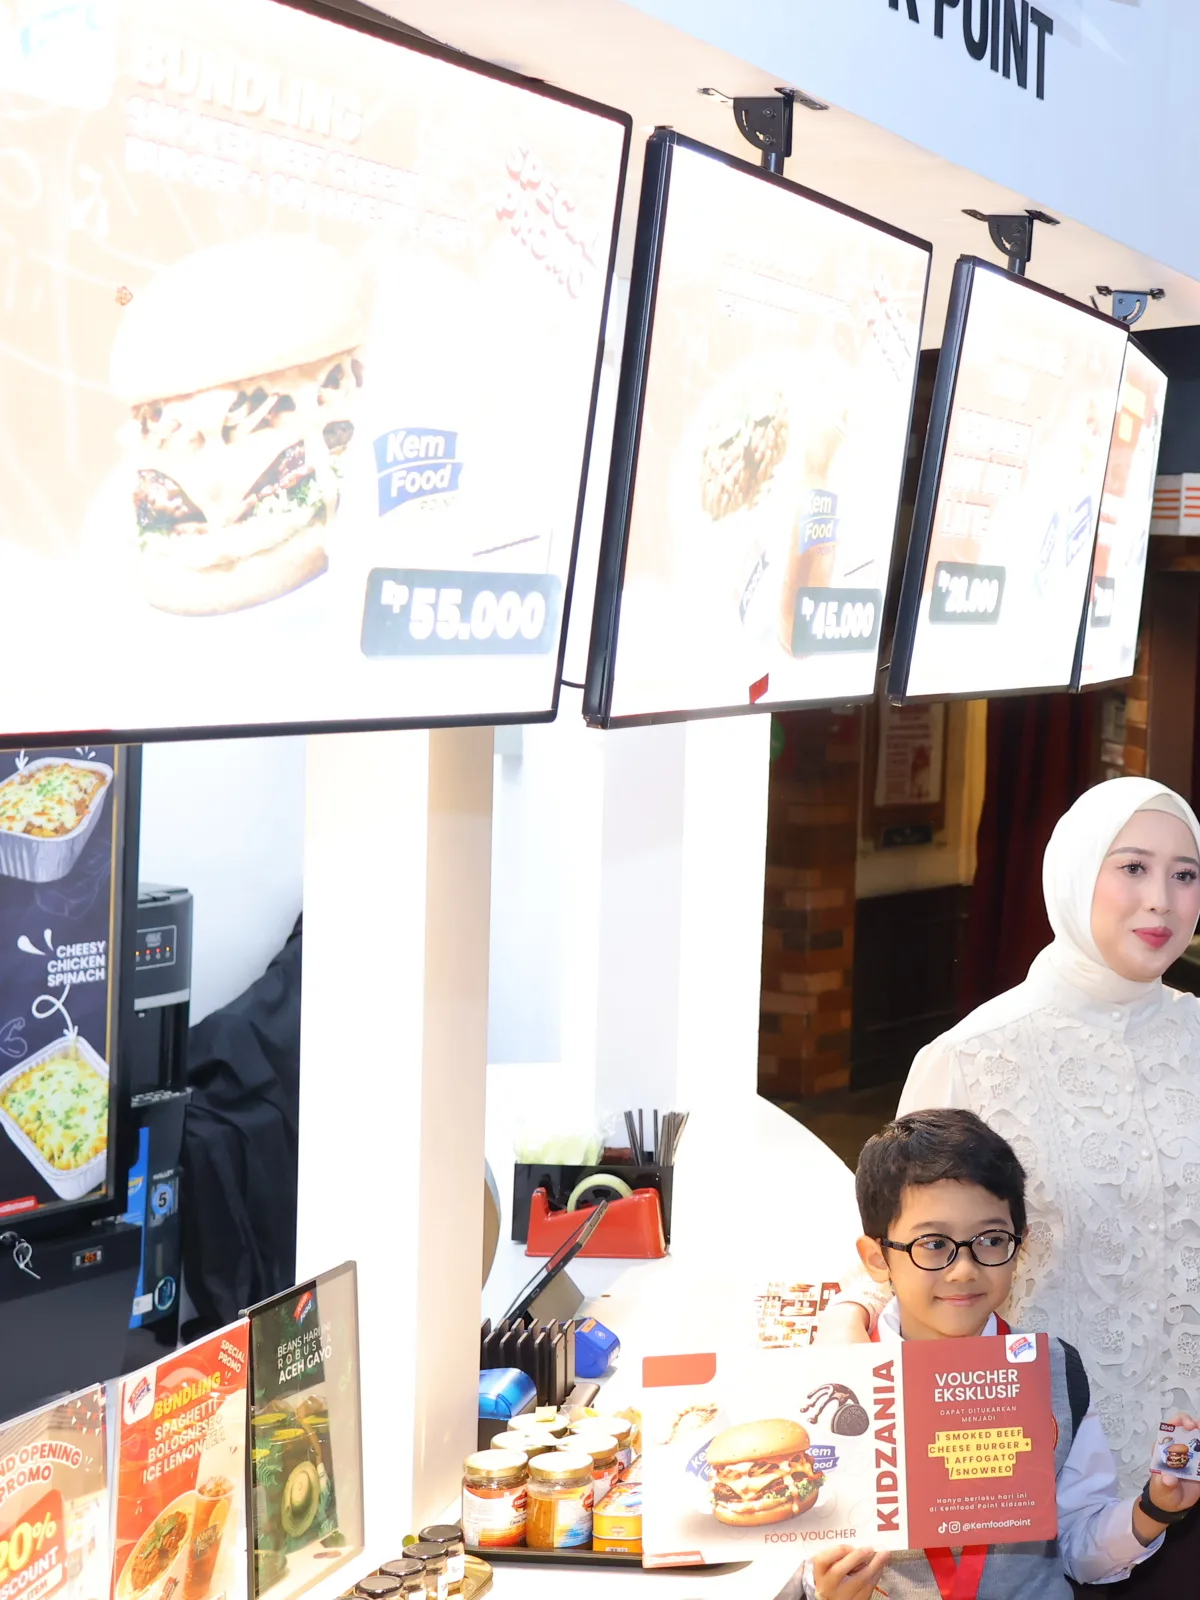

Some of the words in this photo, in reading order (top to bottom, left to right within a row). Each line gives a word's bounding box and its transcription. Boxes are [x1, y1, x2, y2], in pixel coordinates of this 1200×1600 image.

[386, 430, 446, 463] Kem
[391, 464, 452, 497] Food
[804, 520, 834, 543] Food
[56, 941, 106, 958] CHEESY
[47, 954, 105, 973] CHICKEN
[47, 967, 105, 987] SPINACH
[157, 1192, 167, 1208] 5
[220, 1339, 246, 1364] SPECIAL
[278, 1336, 302, 1357] BEANS
[278, 1334, 332, 1369] ROBUSTA
[218, 1351, 242, 1374] PROMO
[279, 1359, 304, 1385] ACEH
[307, 1345, 332, 1369] GAYO
[935, 1369, 1018, 1387] VOUCHER
[153, 1371, 222, 1420] BUNDLING
[934, 1384, 1021, 1402] EKSKLUSIF
[940, 1408, 965, 1416] DAPAT
[968, 1405, 1017, 1414] DITUKARKAN
[961, 1415, 996, 1423] MENJADI
[155, 1399, 218, 1441] SPAGHETTI
[945, 1431, 992, 1441] SMOKED
[996, 1429, 1022, 1438] BEEF
[873, 1359, 900, 1532] KIDZANIA
[929, 1444, 971, 1454] CHEESE
[976, 1441, 1020, 1451] BURGER
[19, 1443, 81, 1467] OPENING
[143, 1465, 161, 1484] ICE
[164, 1443, 204, 1477] LEMON
[955, 1453, 1015, 1465] AFFOGATO
[813, 1459, 833, 1470] ood
[950, 1465, 1012, 1478] /SNOWREO
[937, 1497, 962, 1505] Hanya
[965, 1495, 995, 1503] berlaku
[998, 1493, 1014, 1501] hari
[940, 1504, 975, 1512] Kemfood
[978, 1502, 998, 1510] Point
[1001, 1500, 1035, 1508] Kidzania
[962, 1518, 1031, 1532] @KemfoodPoint
[765, 1533, 797, 1544] FOOD
[801, 1529, 856, 1542] VOUCHER
